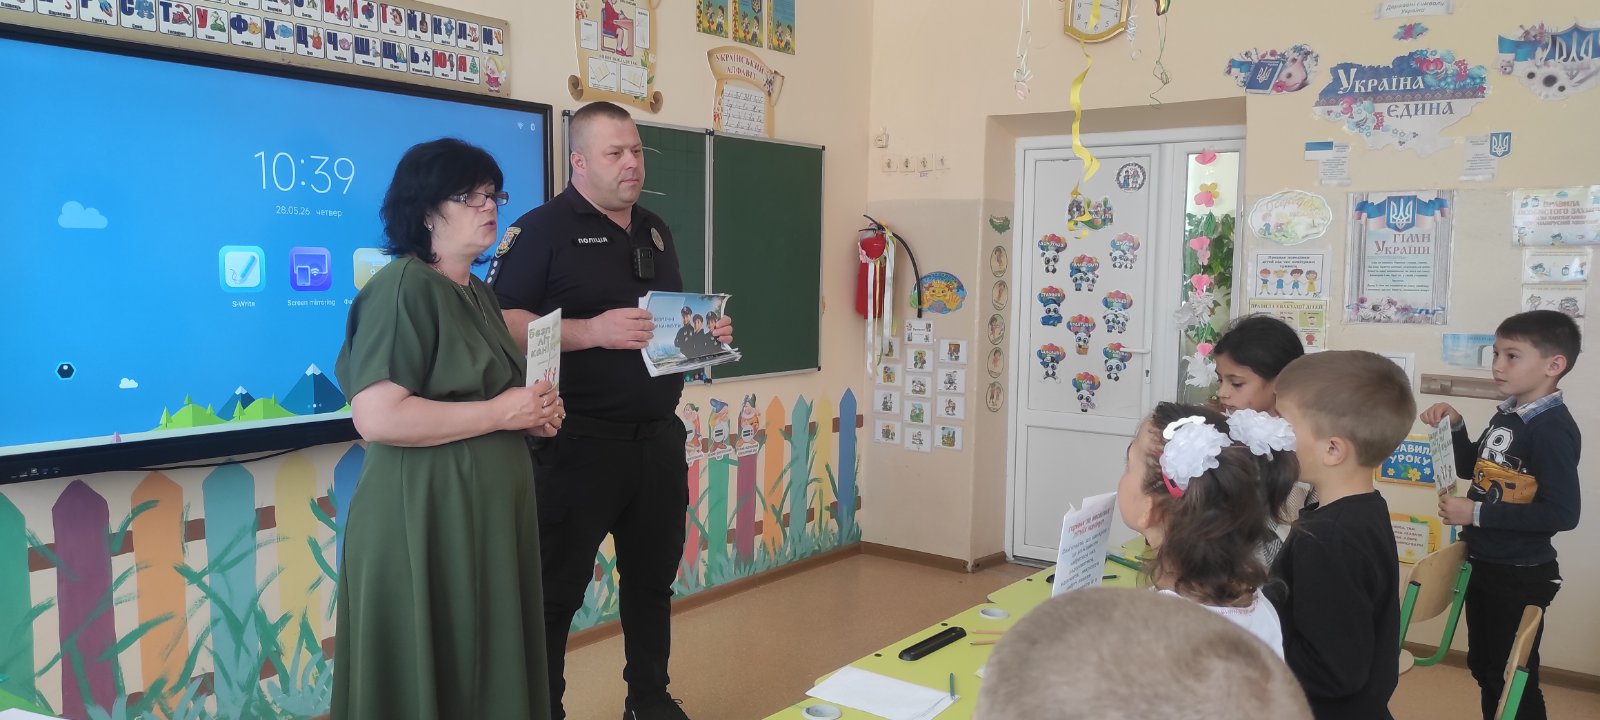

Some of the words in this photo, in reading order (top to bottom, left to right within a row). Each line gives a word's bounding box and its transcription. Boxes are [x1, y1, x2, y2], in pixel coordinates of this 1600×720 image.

[160, 2, 172, 22] Т
[230, 15, 248, 34] Ф
[254, 151, 355, 195] 10:39
[276, 205, 310, 216] 28.05.26
[316, 209, 343, 217] четвер
[1392, 233, 1431, 243] ГІМН
[310, 299, 335, 307] mirroring
[1397, 442, 1433, 454] АВИЛ
[1389, 454, 1431, 465] УРОКУ
